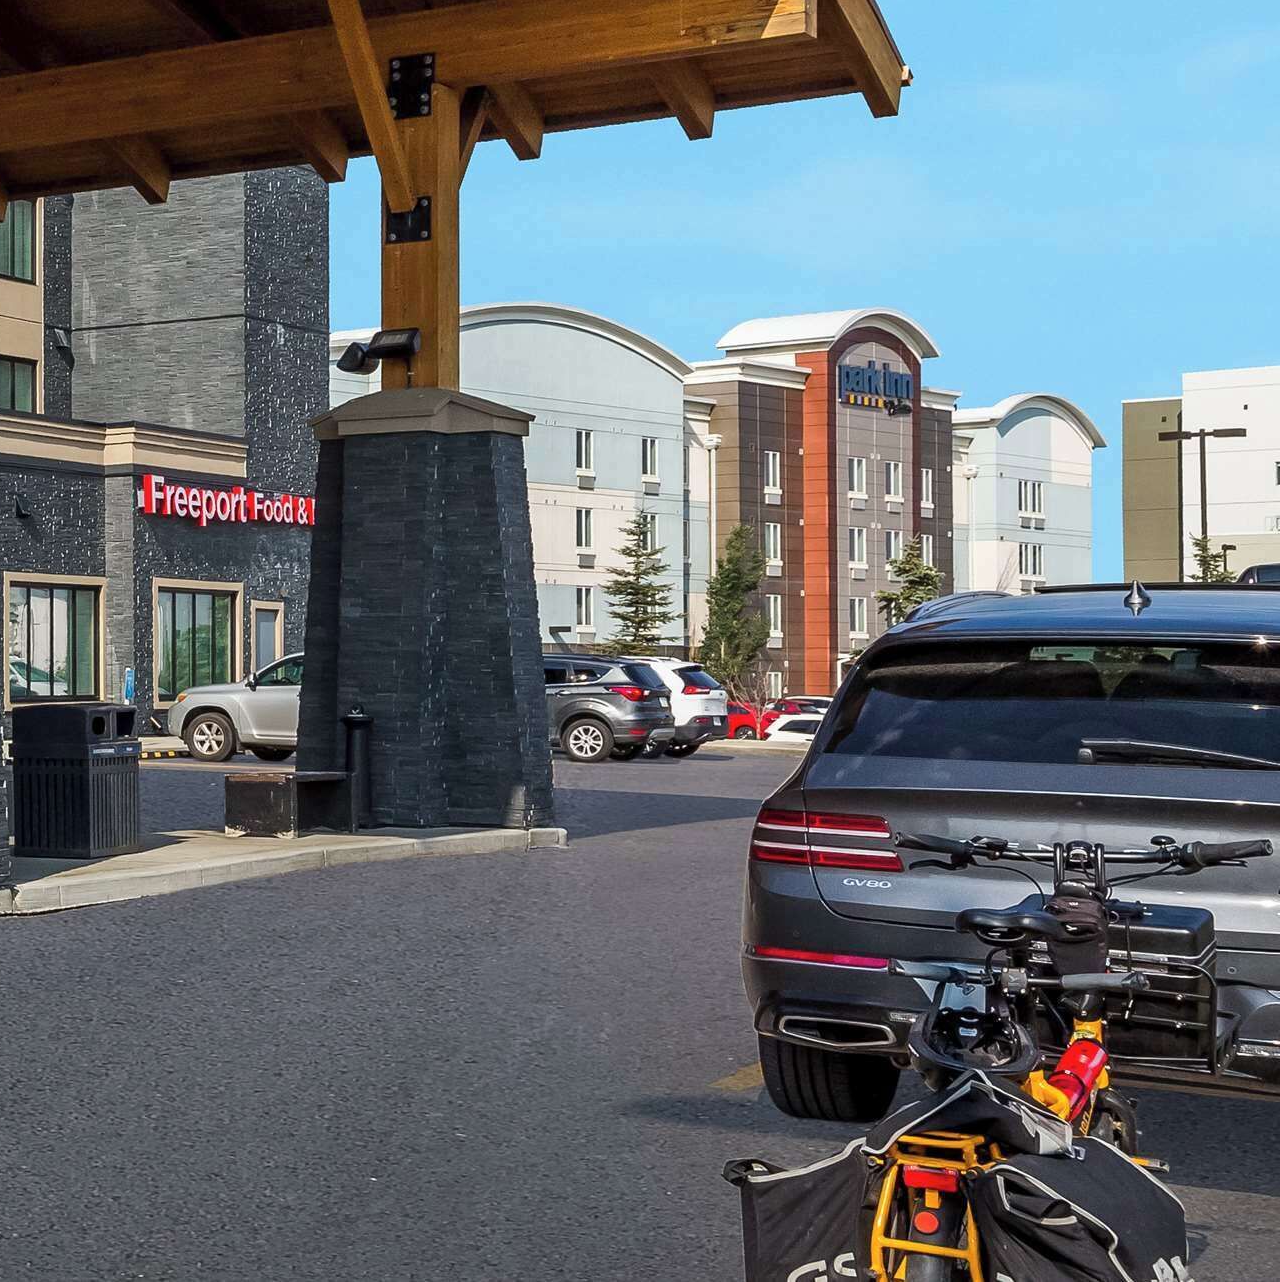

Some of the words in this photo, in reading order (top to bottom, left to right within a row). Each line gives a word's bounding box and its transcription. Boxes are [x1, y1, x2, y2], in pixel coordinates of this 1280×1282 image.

[838, 361, 881, 399] park
[883, 363, 914, 399] inn
[145, 474, 247, 526] Freeport
[252, 491, 294, 524] Food
[298, 497, 309, 525] &
[843, 878, 892, 889] GV80
